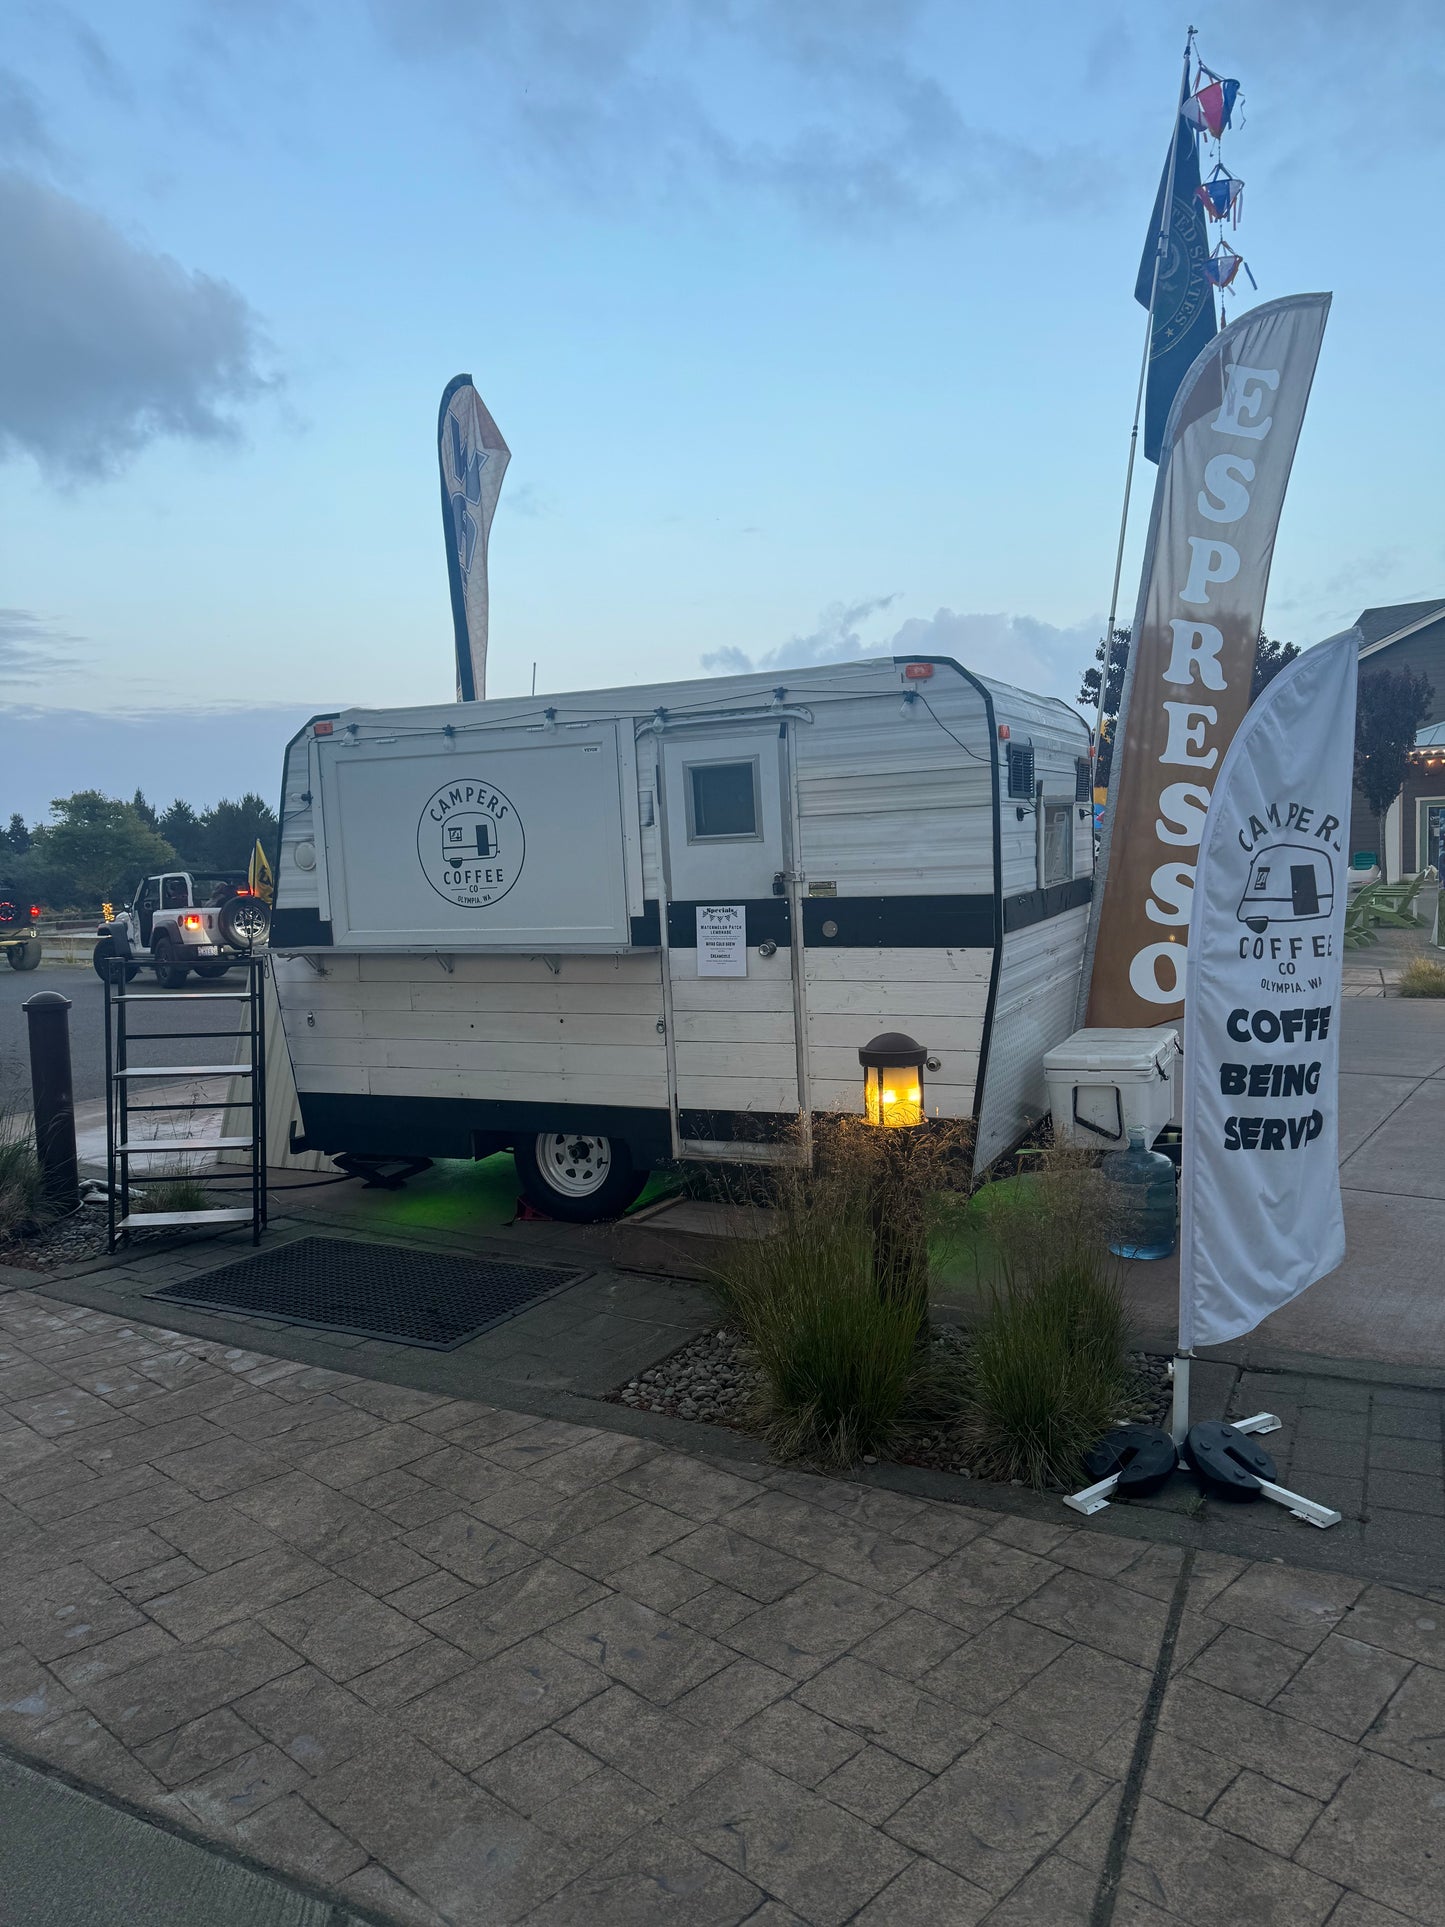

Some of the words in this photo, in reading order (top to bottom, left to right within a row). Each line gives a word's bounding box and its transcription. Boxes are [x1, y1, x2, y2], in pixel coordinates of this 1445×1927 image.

[1129, 363, 1280, 1005] ESPRESSO
[430, 787, 508, 821] CAMPERS
[443, 868, 504, 885] COFFEE
[469, 884, 479, 893] CO
[482, 894, 492, 902] WA
[1278, 962, 1296, 975] CO
[1219, 1061, 1322, 1097] BEING
